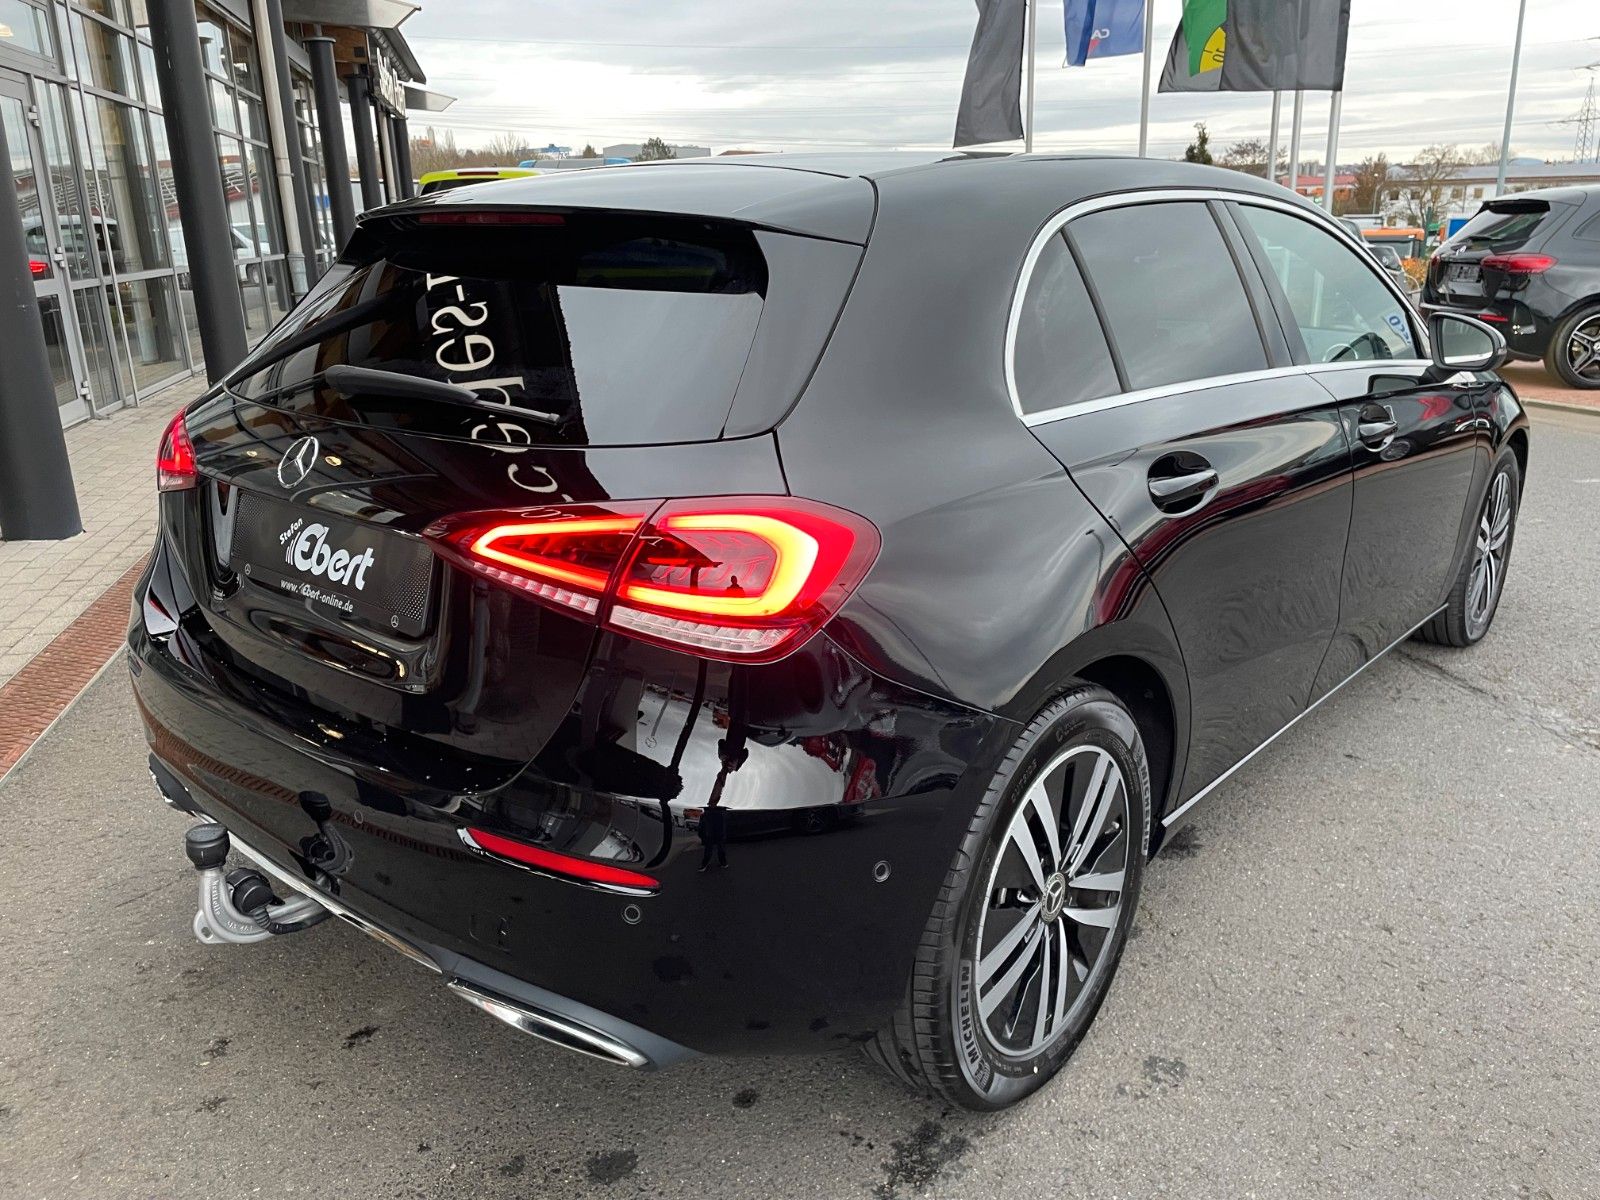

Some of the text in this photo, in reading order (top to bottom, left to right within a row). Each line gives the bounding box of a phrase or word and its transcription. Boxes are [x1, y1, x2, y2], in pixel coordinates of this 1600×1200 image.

[279, 517, 303, 545] Stefan
[293, 523, 375, 591] Ebert
[1140, 764, 1149, 851] MICHELIN
[960, 965, 980, 1065] MICHELIN
